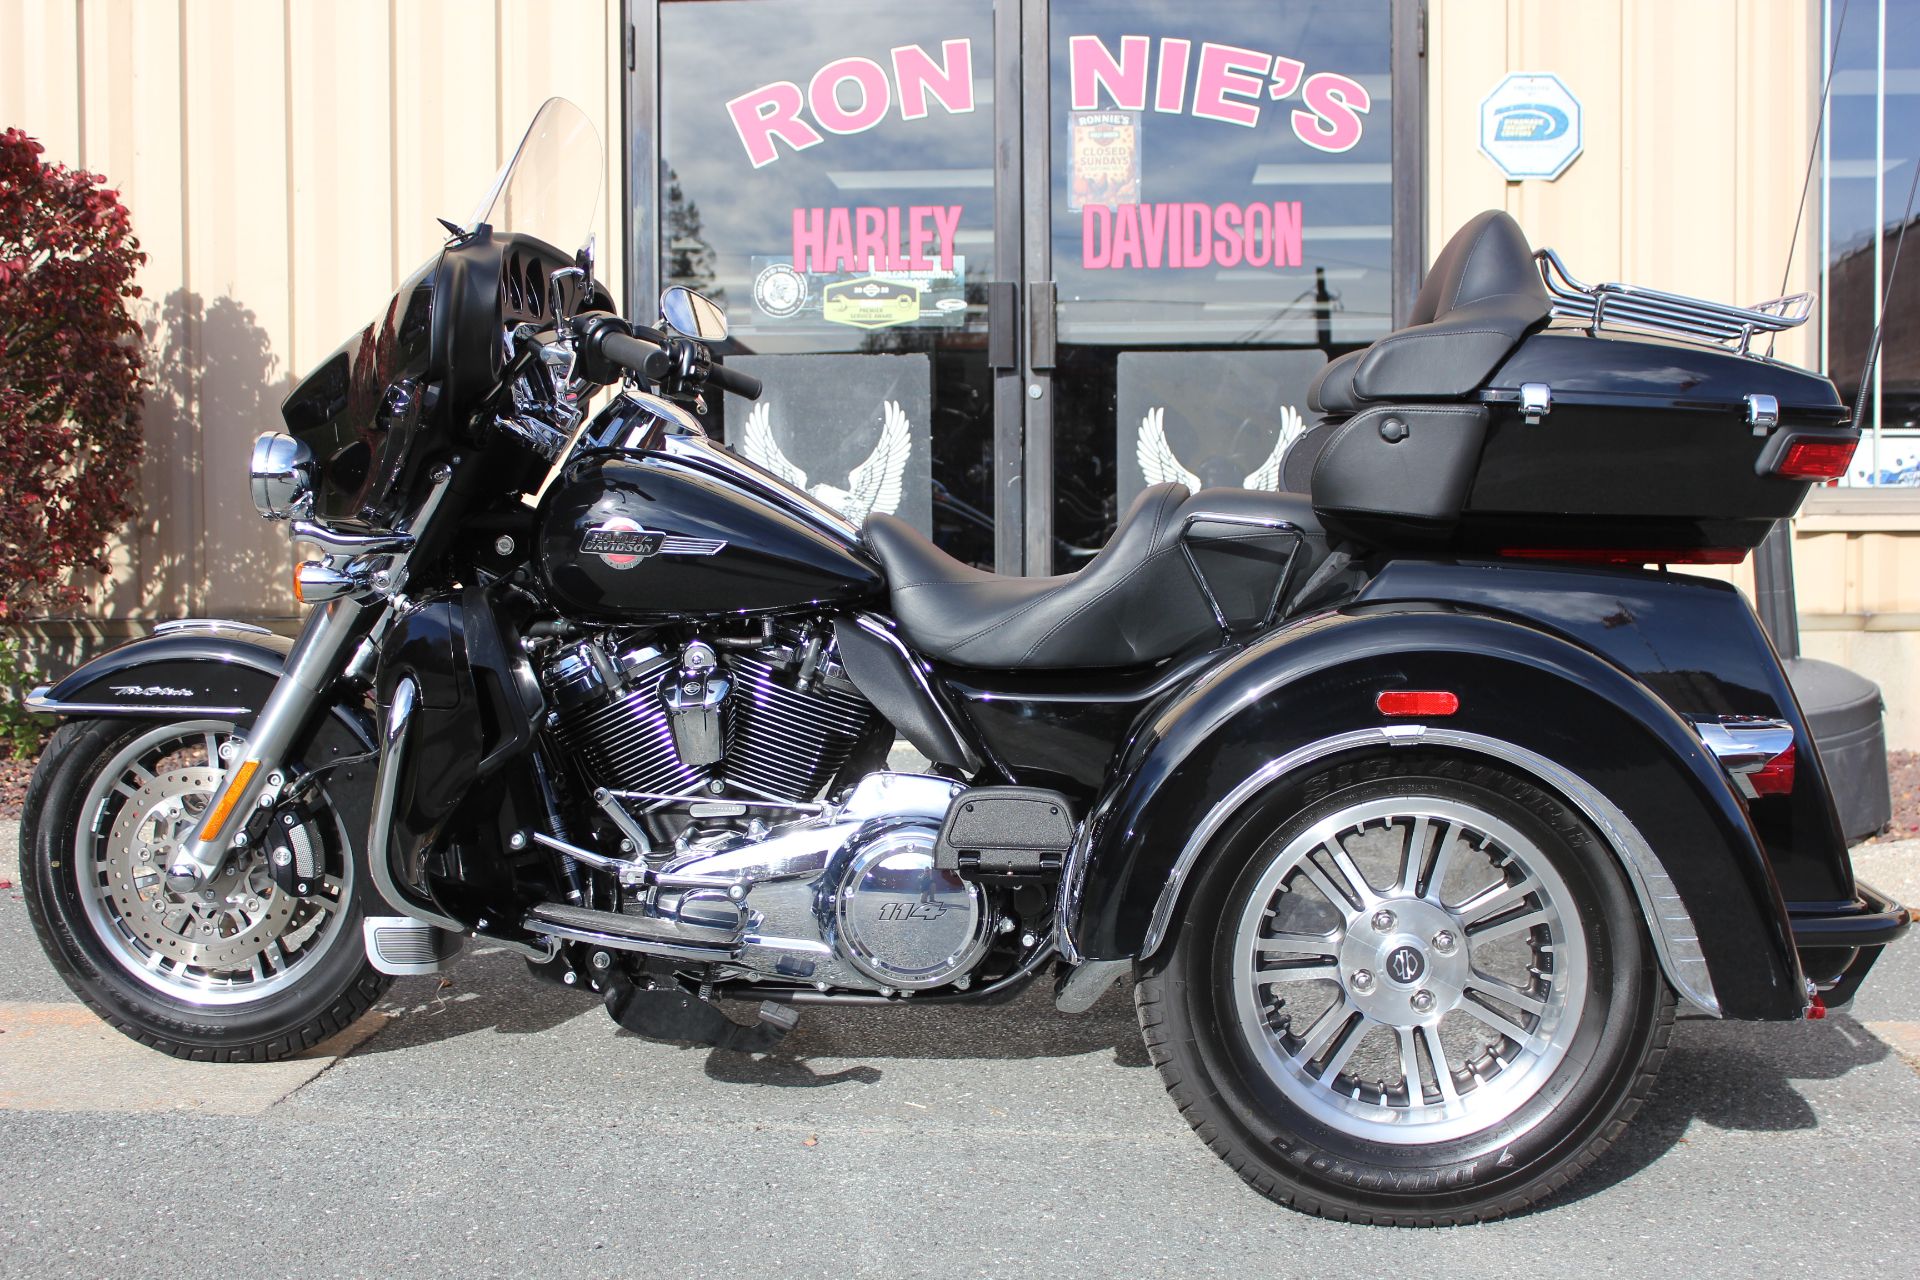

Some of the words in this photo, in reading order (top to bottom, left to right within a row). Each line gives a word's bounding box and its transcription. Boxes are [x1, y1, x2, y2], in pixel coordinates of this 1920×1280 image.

[725, 38, 974, 169] RON
[1069, 35, 1371, 153] NIE'S
[1078, 114, 1130, 125] RONNIE'S
[1082, 147, 1126, 156] CLOSED
[1080, 156, 1129, 166] SUNDAYS
[792, 205, 963, 273] HARLEY
[1082, 201, 1303, 270] DAVIDSON
[584, 540, 653, 553] DAVIDSON
[879, 902, 947, 920] 114
